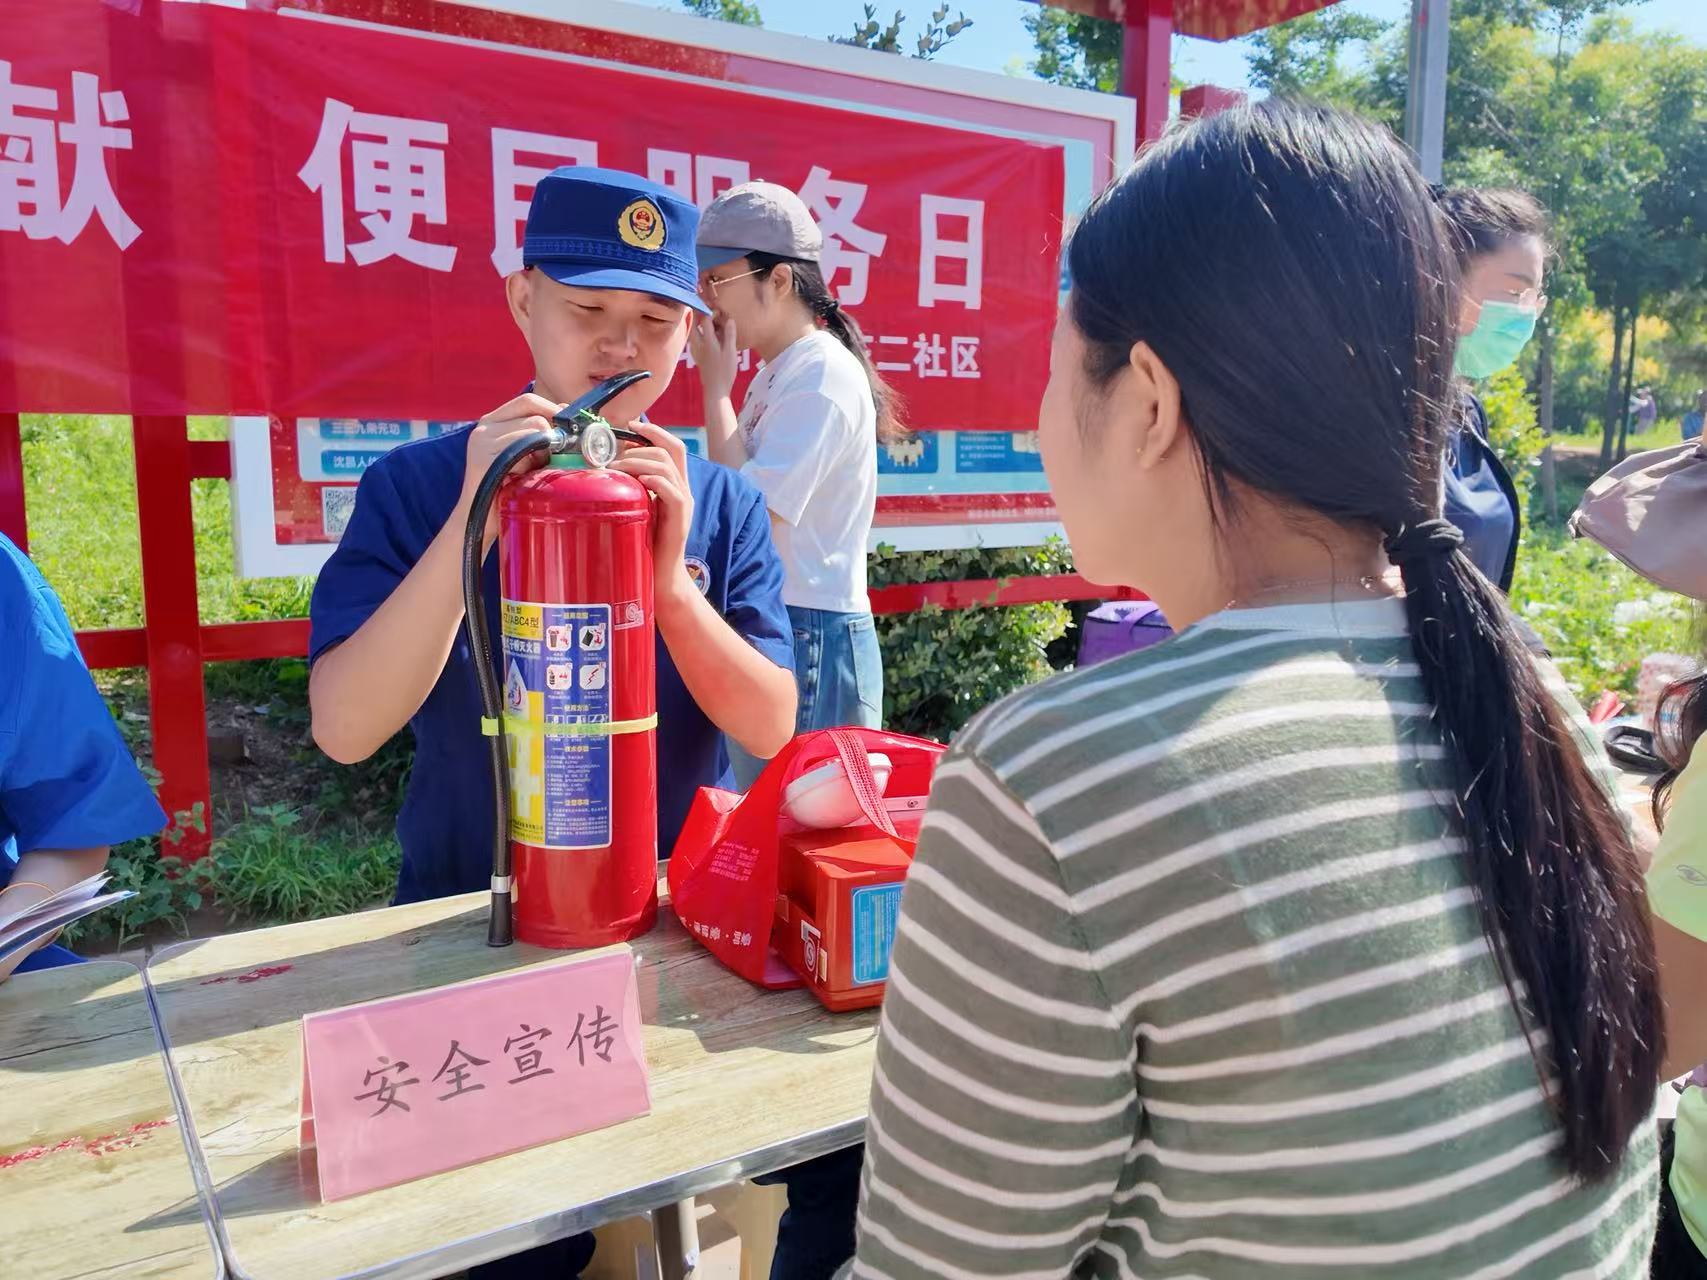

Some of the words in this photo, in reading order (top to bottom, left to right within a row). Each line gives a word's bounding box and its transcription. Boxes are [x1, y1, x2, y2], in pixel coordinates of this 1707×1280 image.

[0, 59, 143, 251] 献
[862, 332, 981, 379] 二社区
[353, 1005, 619, 1118] 安全宣传
